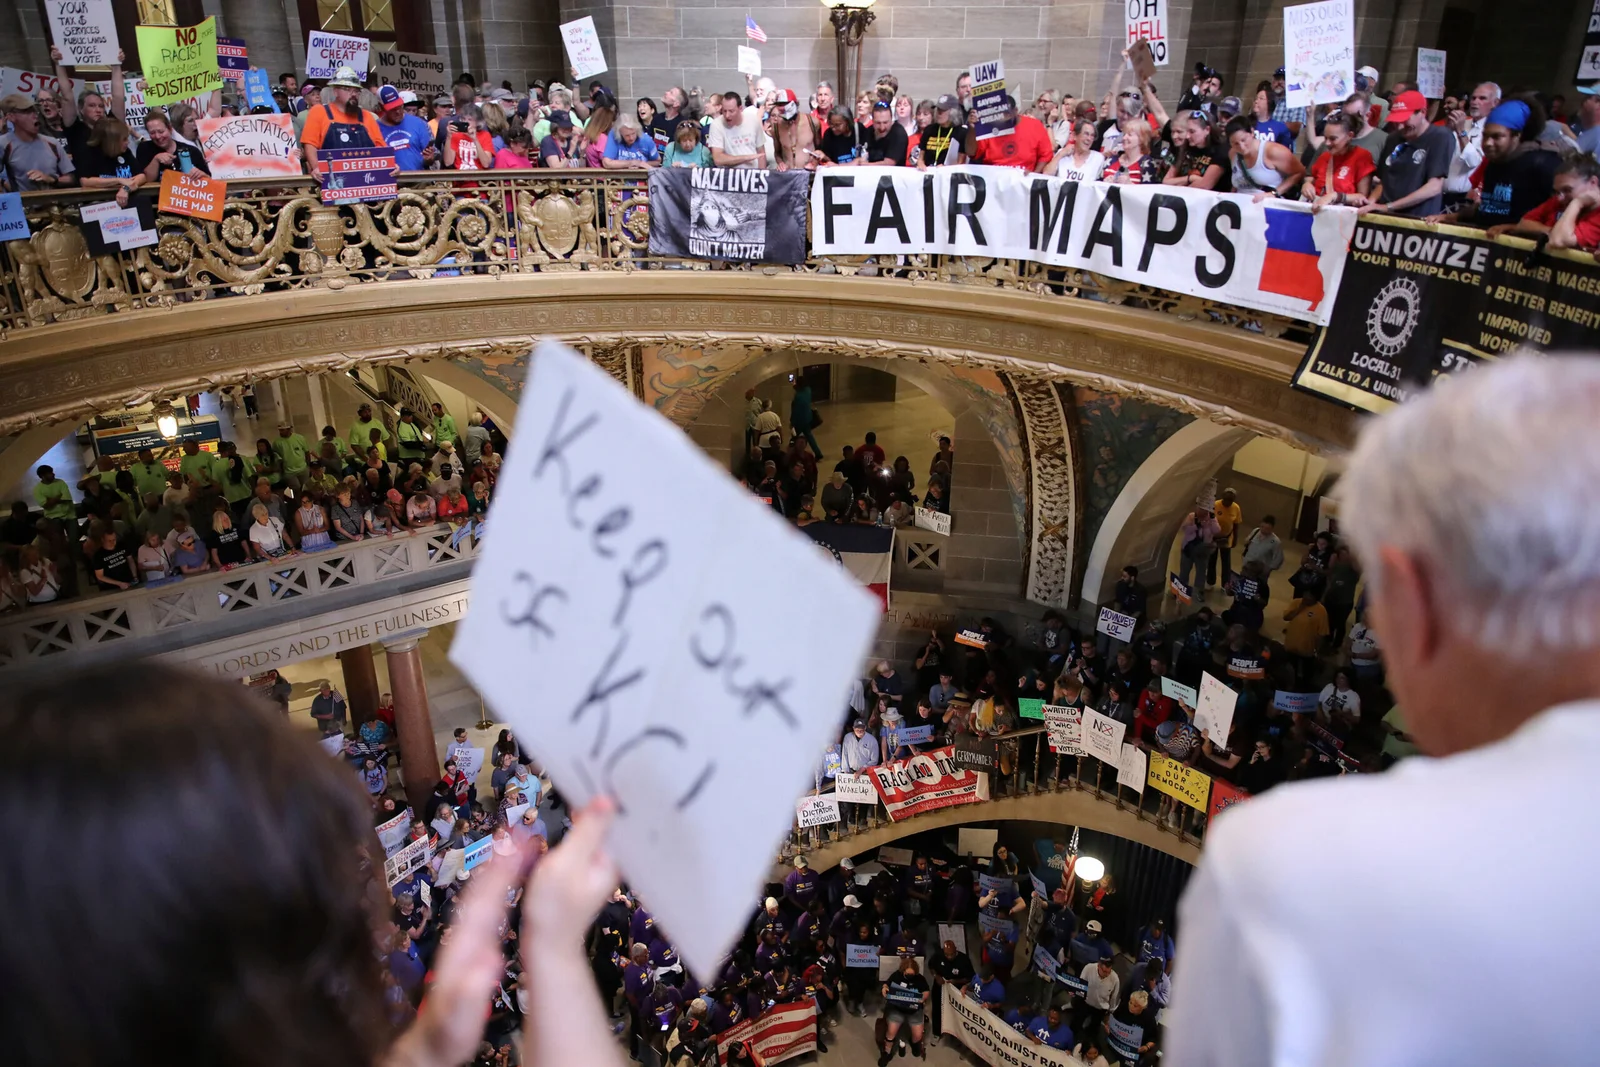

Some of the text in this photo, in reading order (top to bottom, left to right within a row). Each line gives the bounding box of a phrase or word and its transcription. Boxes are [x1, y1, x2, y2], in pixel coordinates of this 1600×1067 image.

[58, 1, 88, 15] YOUR
[1129, 0, 1157, 20] OH
[1289, 4, 1347, 26] MISSOURI
[57, 15, 87, 26] TAX $
[63, 26, 100, 36] SERVICES
[175, 28, 197, 47] NO
[1129, 20, 1164, 44] HELL
[1294, 21, 1344, 39] VOTERS ARE
[63, 36, 107, 45] PUBLIC LANDS
[312, 37, 368, 51] ONLY LOSERS
[70, 46, 99, 55] VOICE
[161, 43, 202, 63] RACIST
[218, 47, 242, 56] EFEND
[320, 49, 356, 60] CHEAT
[75, 55, 102, 63] VOTE
[328, 60, 344, 68] NO
[379, 51, 444, 73] NO Cheating
[150, 62, 202, 78] Republican
[310, 67, 367, 80] REDISTNG
[400, 68, 416, 80] NO
[975, 62, 998, 82] UAW
[17, 72, 74, 93] STO
[973, 82, 1003, 95] STAND UP
[977, 95, 1001, 107] SAVING
[981, 113, 1004, 124] DREAM
[204, 119, 297, 153] REPRESENTATION
[343, 160, 387, 170] DEFEND
[180, 175, 208, 189] STOP
[363, 172, 376, 184] the
[691, 167, 769, 193] NAZI LIVES
[1066, 169, 1084, 180] YOU
[171, 186, 214, 202] RIGGING
[325, 186, 396, 199] CONSTITUTION
[169, 197, 188, 209] THE
[190, 201, 213, 213] MAP
[822, 172, 1241, 289] FAIR MAPS
[689, 238, 765, 259] DON'T MATTER
[1354, 227, 1489, 272] UNIONIZE
[1352, 251, 1482, 287] YOUR WORKPLACE
[1494, 285, 1545, 312] BETTER
[1383, 306, 1408, 328] UAW
[1485, 312, 1552, 345] IMPROVED
[1317, 361, 1406, 402] TALK TO A UNION
[534, 386, 799, 731] Keep Out
[962, 629, 985, 640] PEOPLE
[1107, 623, 1121, 634] LOL
[216, 645, 281, 675] LORD'S
[287, 636, 330, 658] AND
[333, 624, 370, 645] THE
[374, 605, 450, 634] FULLNESS
[1232, 658, 1258, 668] PEOPLE
[1045, 707, 1077, 716] WANTED
[956, 750, 993, 766] GERRYMANDER
[878, 762, 933, 788] RACIAL
[1168, 761, 1191, 777] SAVE
[1165, 770, 1187, 784] OUR
[1150, 771, 1200, 804] DEMOCRACY
[813, 801, 824, 809] NO
[904, 795, 925, 806] BLACK
[802, 805, 834, 818] DICTATOR
[802, 814, 837, 827] MISSOURI
[465, 854, 476, 864] MY
[724, 1019, 752, 1038] DEMOCRA
[755, 1016, 783, 1031] FREEDOM
[949, 994, 1038, 1060] UNITED AGAINST
[1114, 1023, 1134, 1035] PEOPLE
[963, 1021, 1018, 1066] GOOD JOBS
